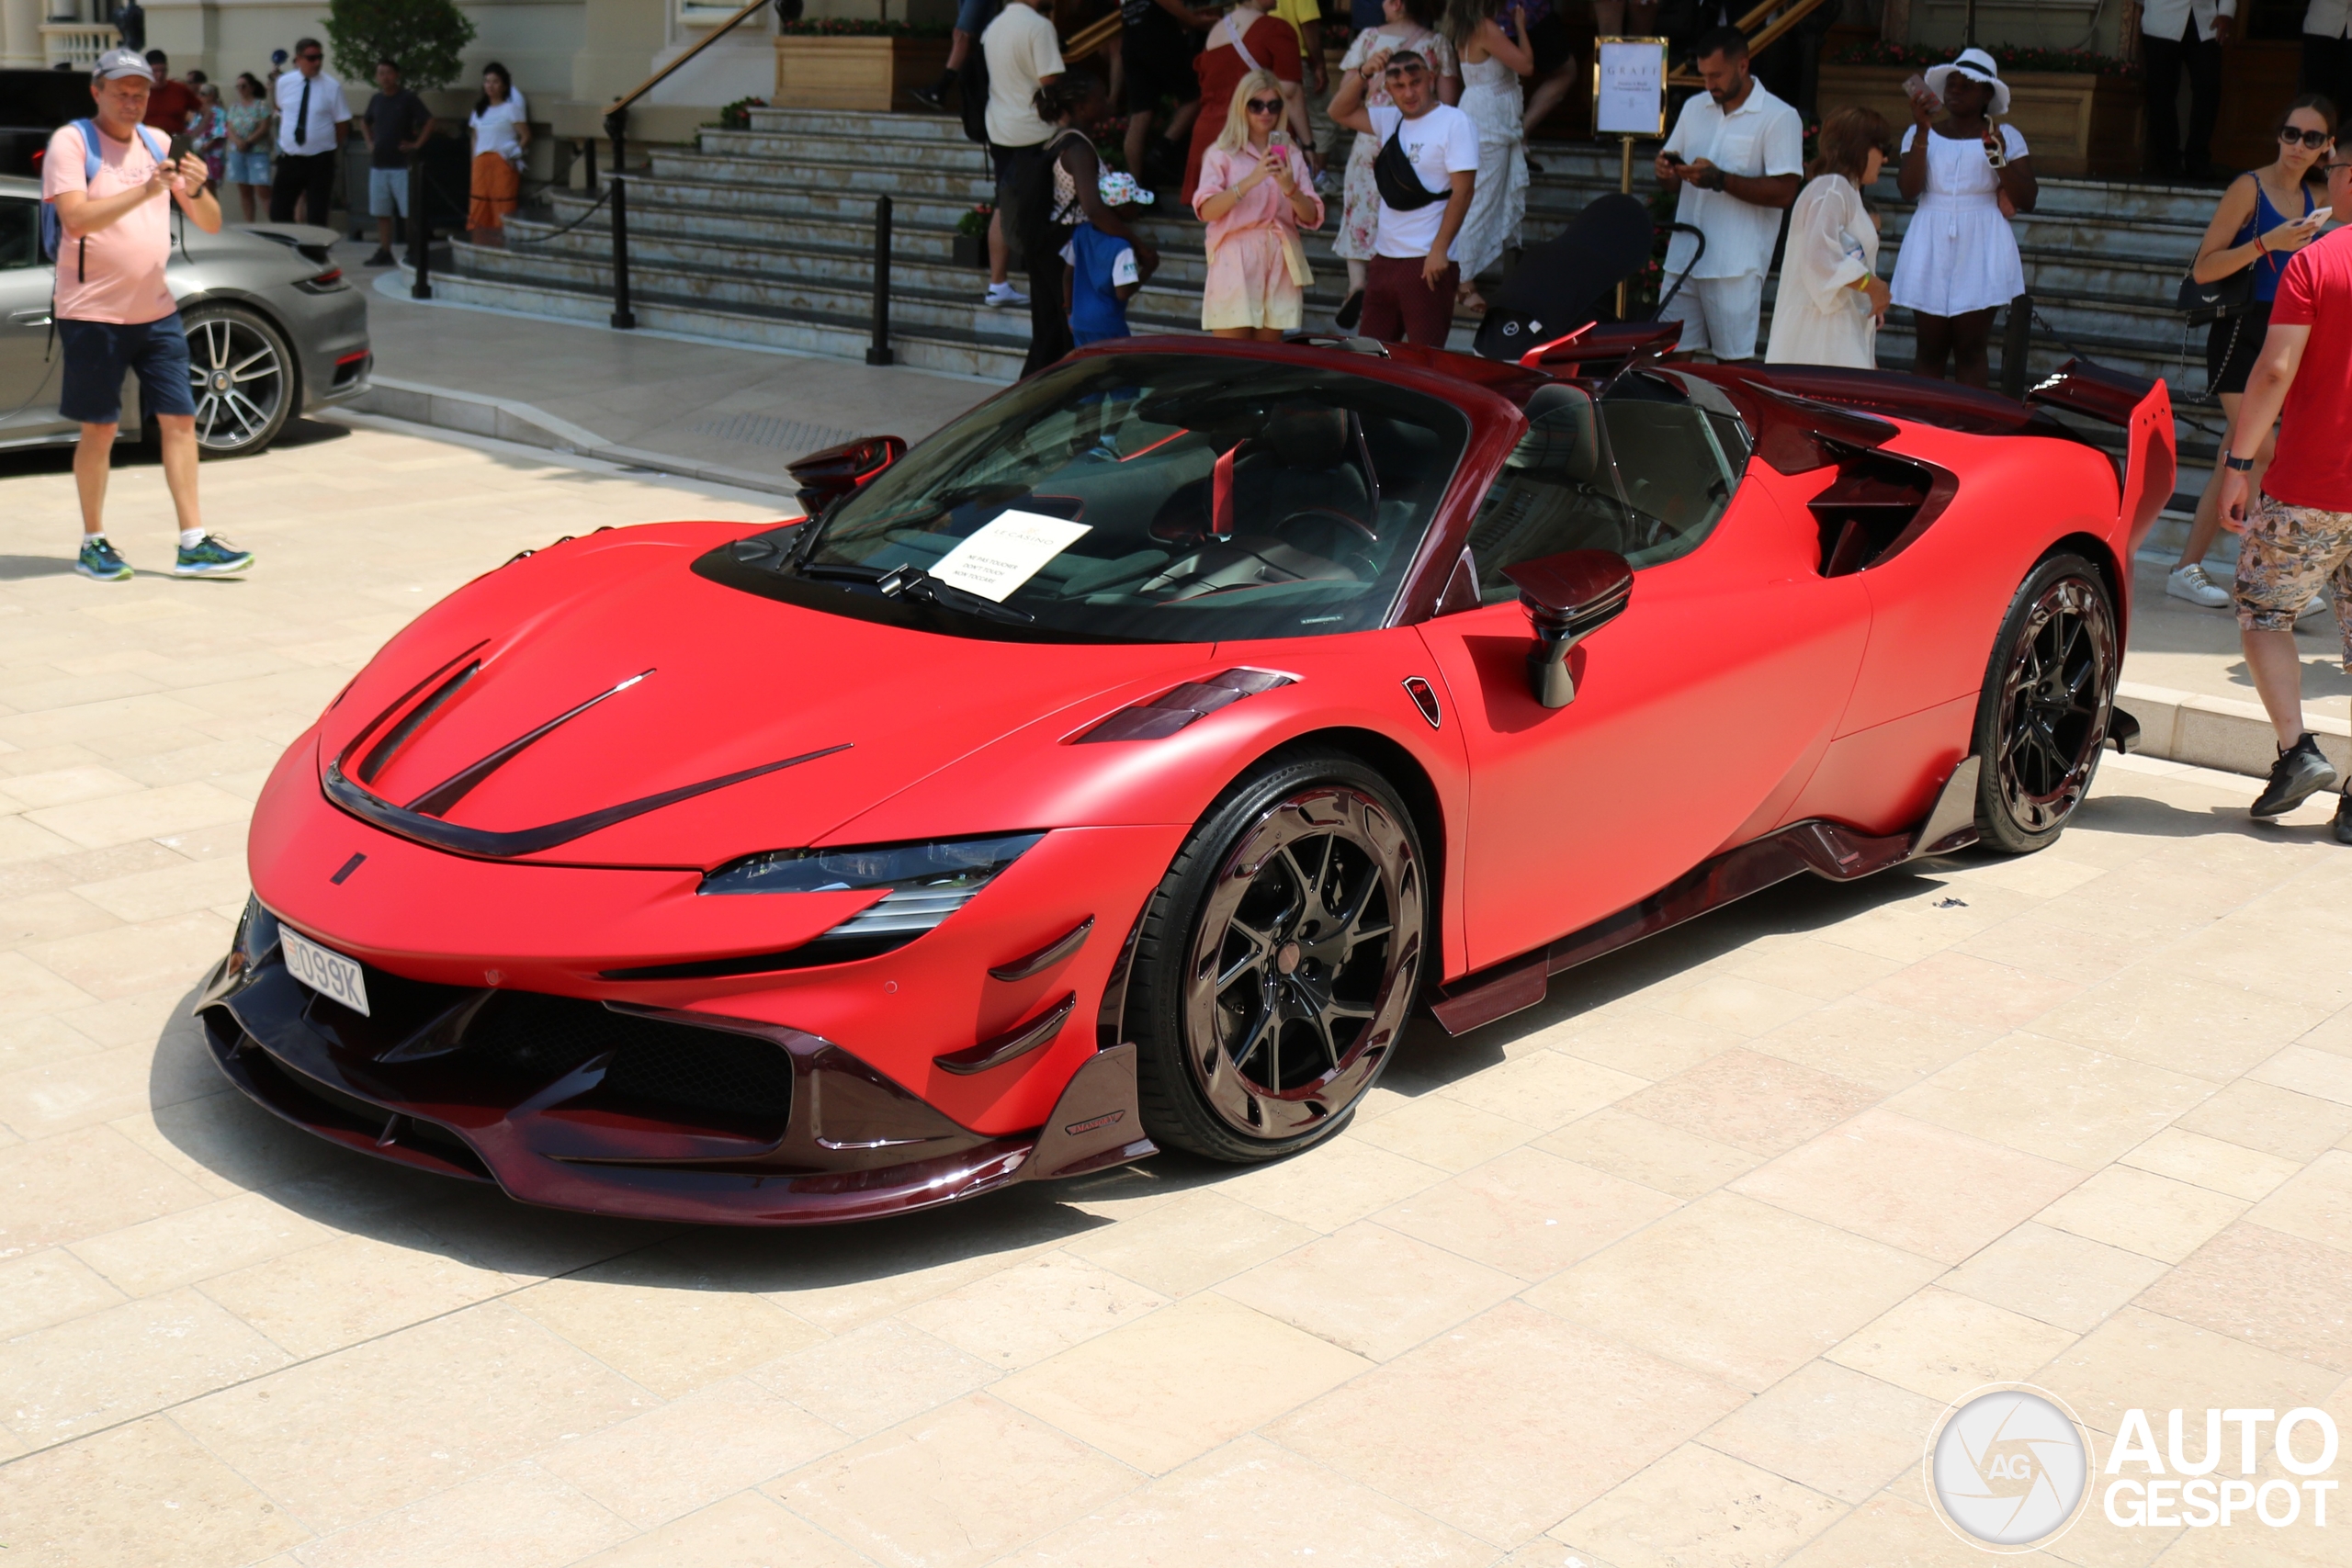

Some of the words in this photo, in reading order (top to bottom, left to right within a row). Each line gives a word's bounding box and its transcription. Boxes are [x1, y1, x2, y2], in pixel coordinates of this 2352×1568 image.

[1608, 66, 1657, 75] GRAFF
[1009, 532, 1054, 545] CASINO
[963, 562, 984, 570] DON'T
[983, 567, 1005, 576] TOUCH
[989, 559, 1019, 570] TOUCHER
[953, 570, 969, 578] NON
[968, 573, 997, 583] TOCCARE
[299, 943, 363, 1007] 099K
[1074, 1113, 1115, 1133] MANSORY
